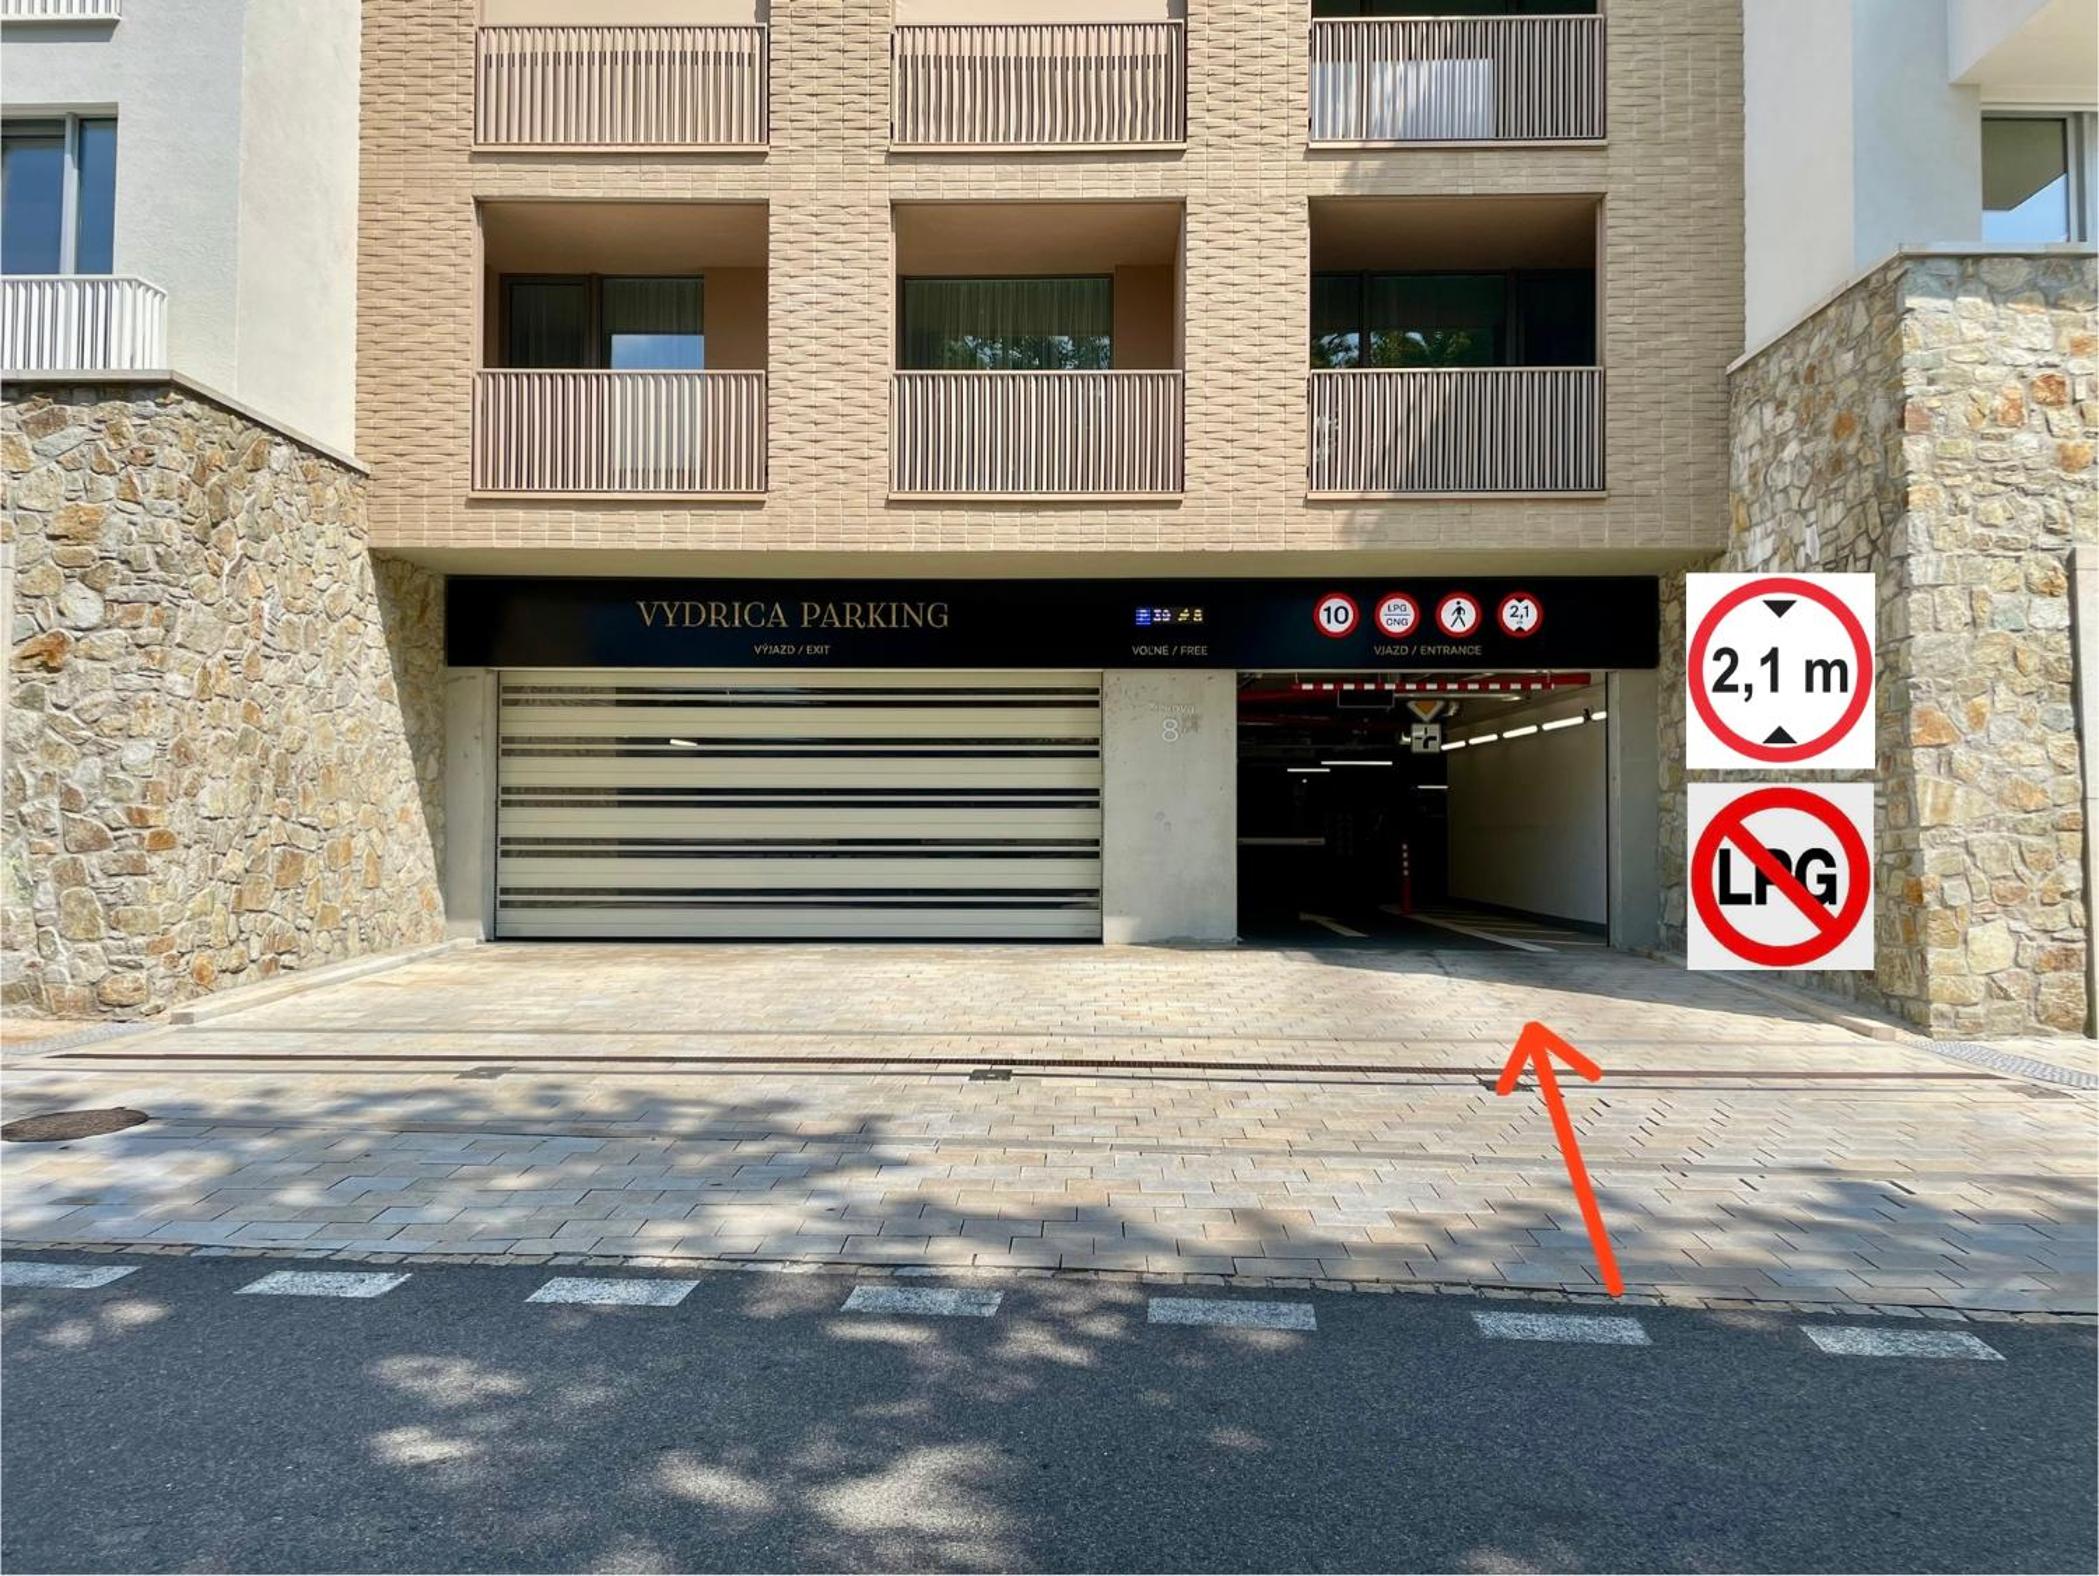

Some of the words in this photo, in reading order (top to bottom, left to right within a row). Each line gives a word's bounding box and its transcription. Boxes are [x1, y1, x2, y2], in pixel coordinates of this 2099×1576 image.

[1387, 603, 1407, 613] LPG
[1510, 605, 1529, 619] 2,1
[636, 601, 789, 628] VYDRICA
[800, 601, 949, 629] PARKING
[1323, 605, 1349, 625] 10
[1386, 617, 1409, 627] CNG
[753, 642, 796, 655] VÝJAZD
[806, 644, 830, 655] EXIT
[1180, 645, 1208, 656] FREE
[1373, 645, 1409, 656] VJAZD
[1420, 645, 1482, 656] ENTRANCE
[1161, 719, 1179, 742] 8
